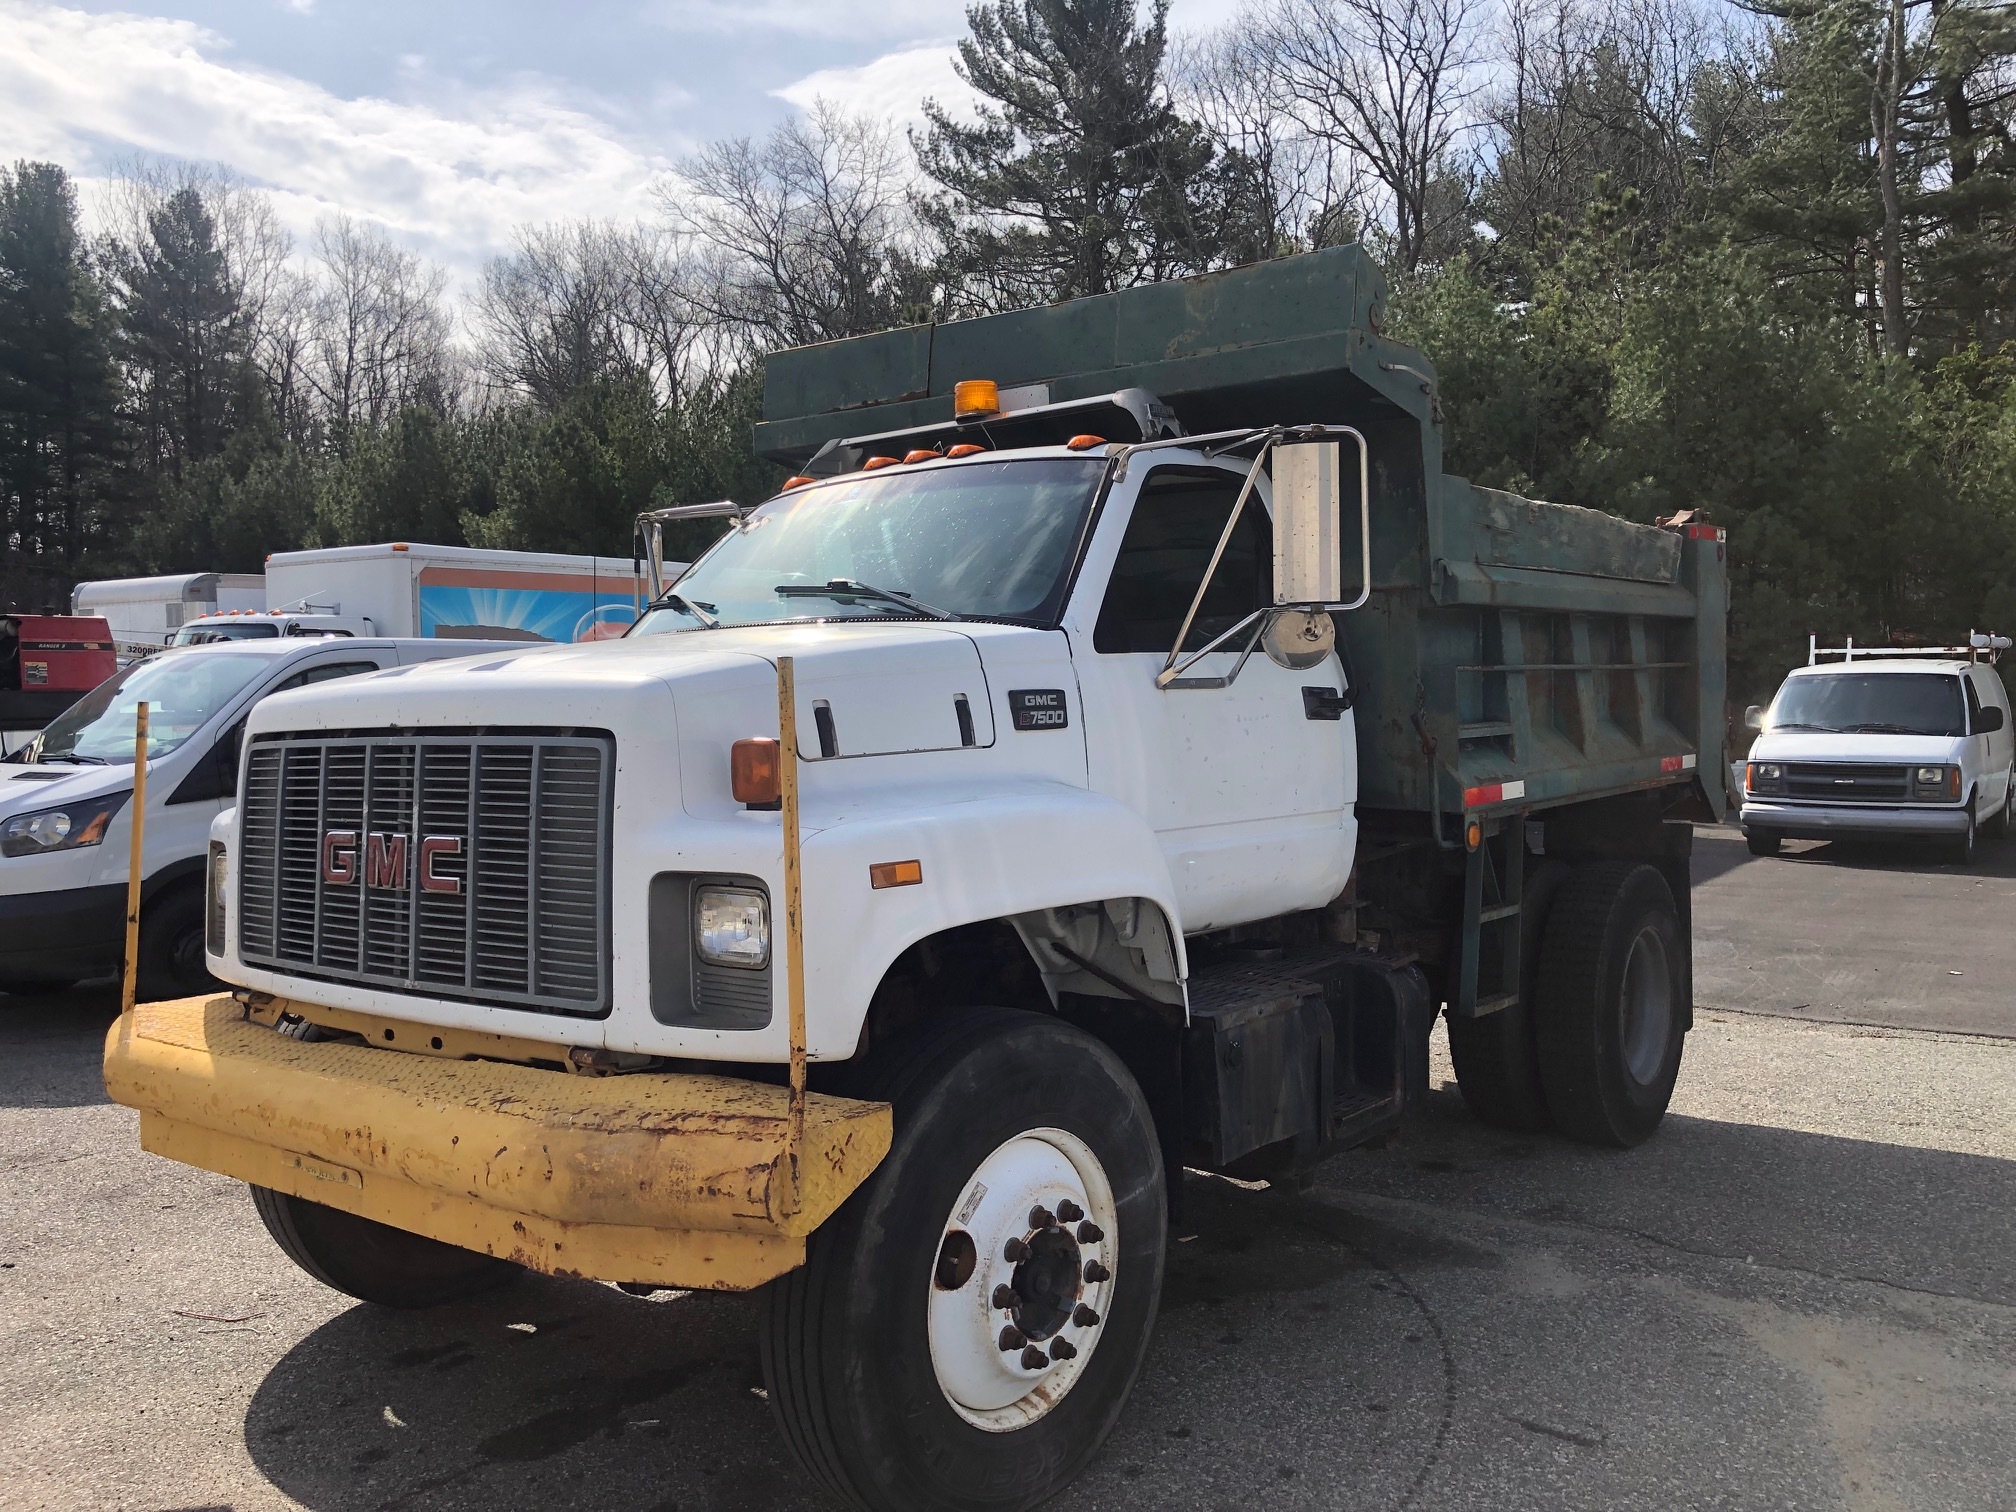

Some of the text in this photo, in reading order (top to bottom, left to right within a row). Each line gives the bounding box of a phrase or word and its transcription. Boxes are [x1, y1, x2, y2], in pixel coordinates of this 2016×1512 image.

[1024, 694, 1058, 706] GMC
[1020, 710, 1064, 725] C7500
[323, 831, 462, 895] GMC
